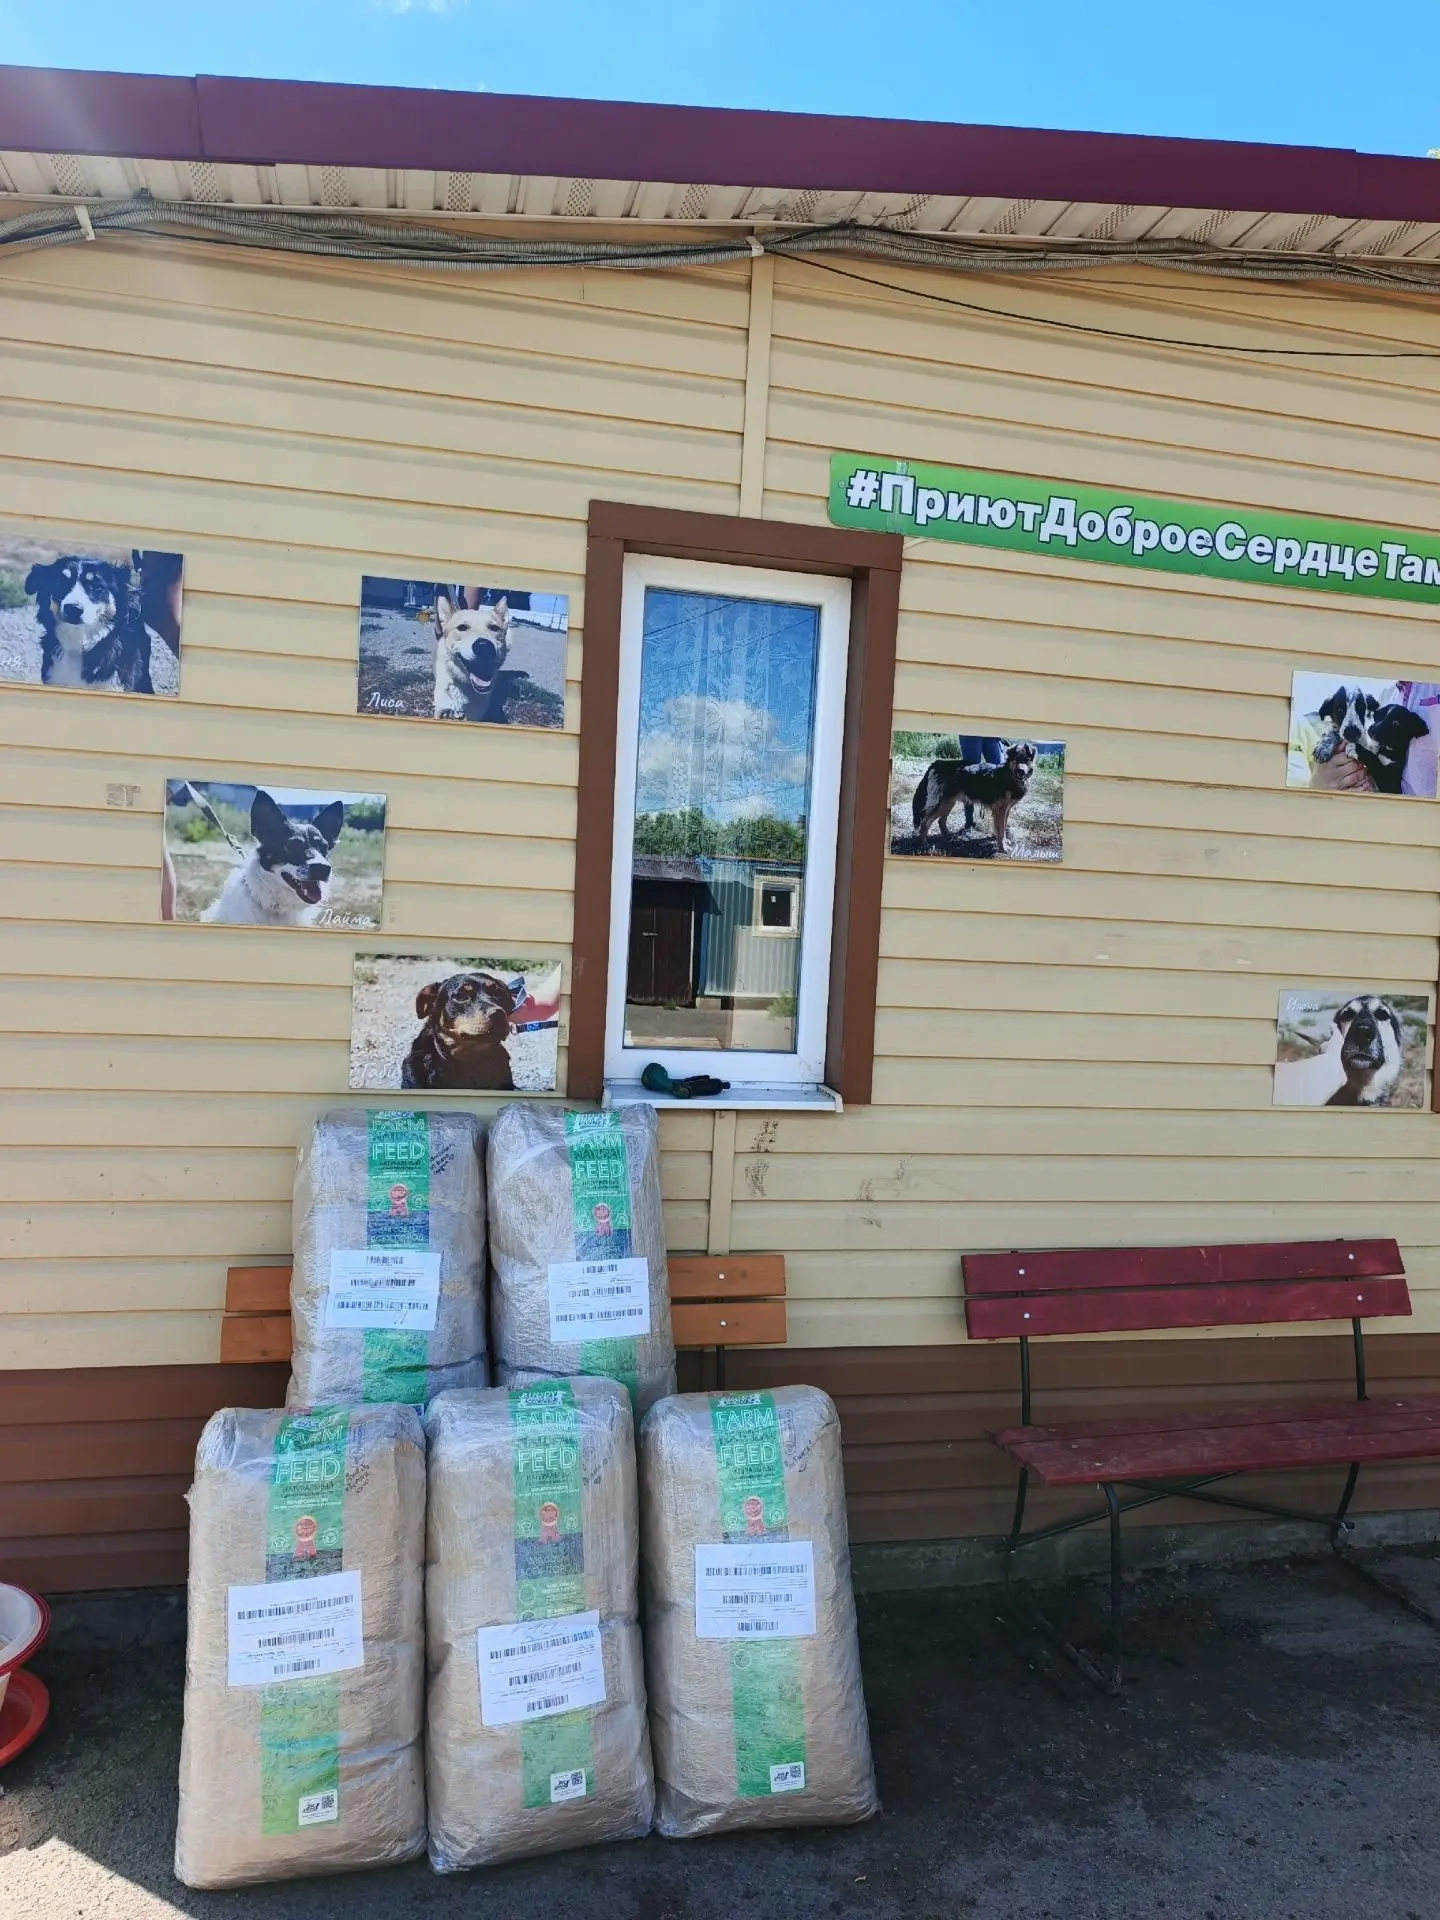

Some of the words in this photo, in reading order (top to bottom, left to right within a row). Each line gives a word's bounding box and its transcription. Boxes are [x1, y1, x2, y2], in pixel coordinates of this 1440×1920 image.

[366, 691, 405, 708] Лиса
[1011, 843, 1059, 859] Малыш
[319, 908, 372, 925] Лайма
[372, 1118, 425, 1131] FARM
[372, 1141, 426, 1160] FEED
[573, 1132, 623, 1151] FARM
[574, 1159, 624, 1179] FEED
[519, 1391, 558, 1399] BUDDY
[516, 1411, 575, 1434] FARM
[715, 1407, 775, 1430] FARM
[280, 1424, 344, 1446] FARM
[518, 1446, 577, 1473] FEED
[720, 1442, 777, 1468] FEED
[275, 1456, 342, 1484] FEED
